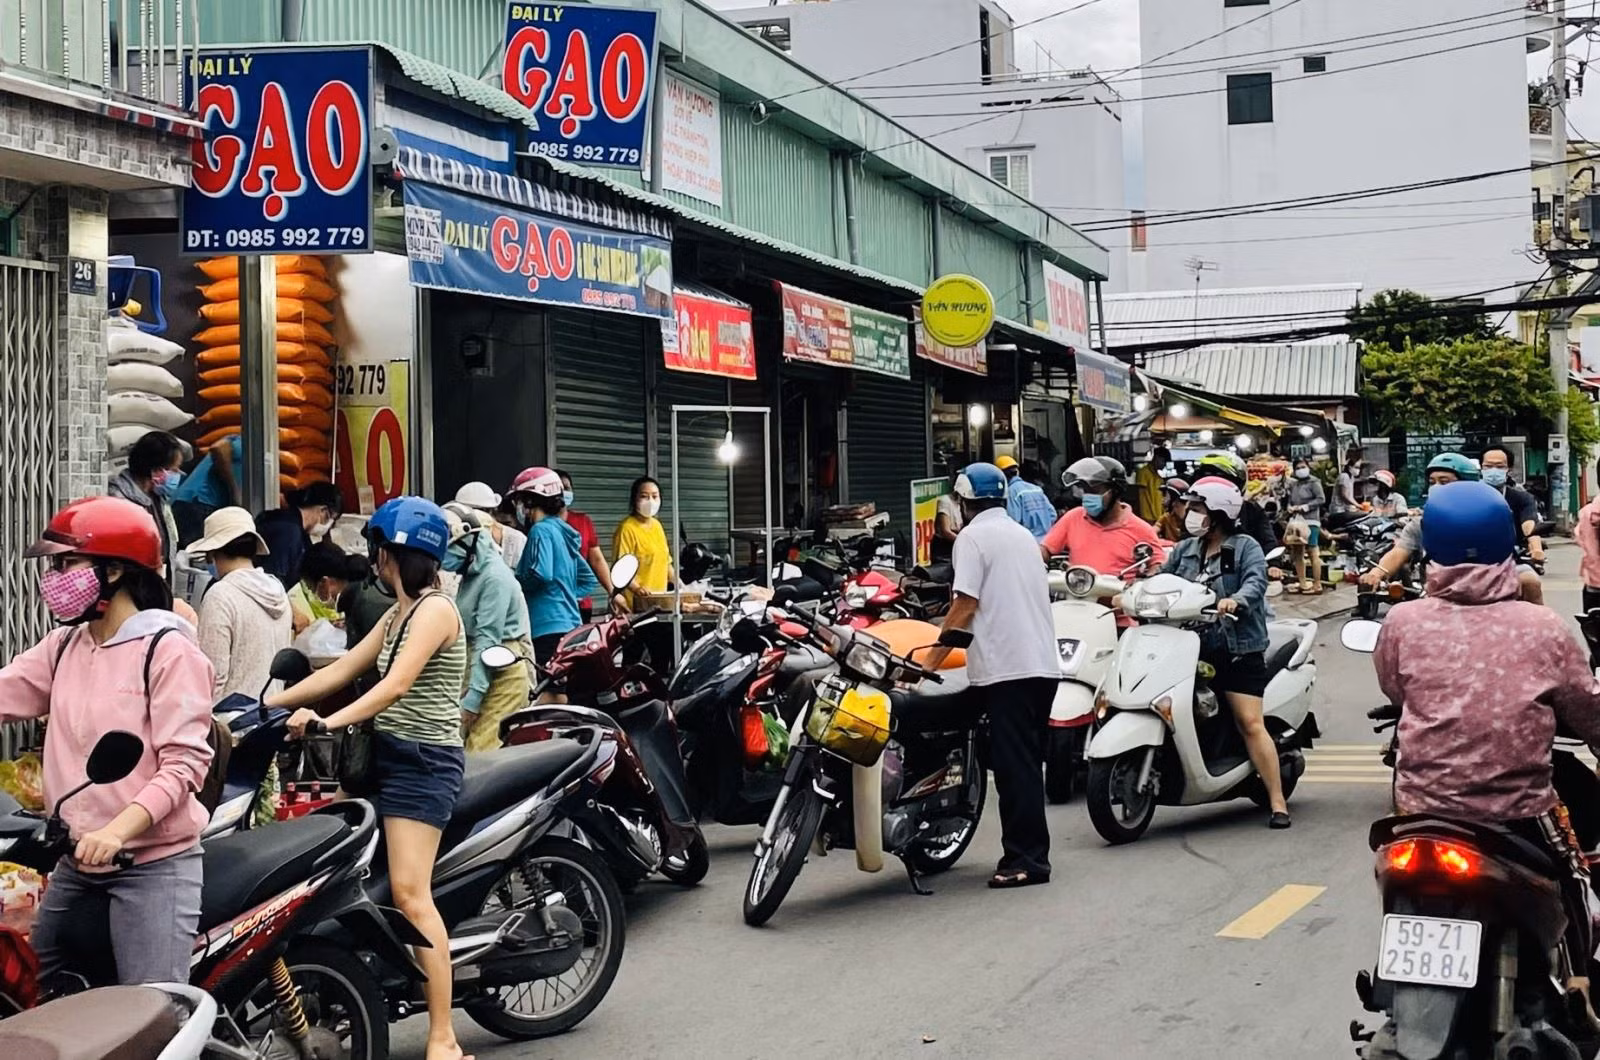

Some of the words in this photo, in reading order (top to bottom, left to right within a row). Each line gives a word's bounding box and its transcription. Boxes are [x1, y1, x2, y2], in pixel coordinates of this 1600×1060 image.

[512, 5, 539, 23] ĐẠI
[543, 4, 564, 22] LÝ
[229, 52, 253, 75] LÝ
[502, 26, 651, 138] GẠO
[192, 80, 367, 222] GẠO
[528, 142, 568, 158] 0985
[573, 145, 604, 160] 992
[609, 147, 639, 163] 779
[188, 230, 219, 248] ĐT:
[225, 229, 275, 247] 0985
[282, 228, 320, 246] 992
[327, 227, 365, 245] 779
[472, 220, 489, 252] LÝ
[491, 215, 575, 293] GẠO
[75, 261, 92, 281] 26
[359, 365, 386, 395] 779
[1398, 920, 1462, 950] 59-Z1
[1385, 949, 1470, 981] 258.84
